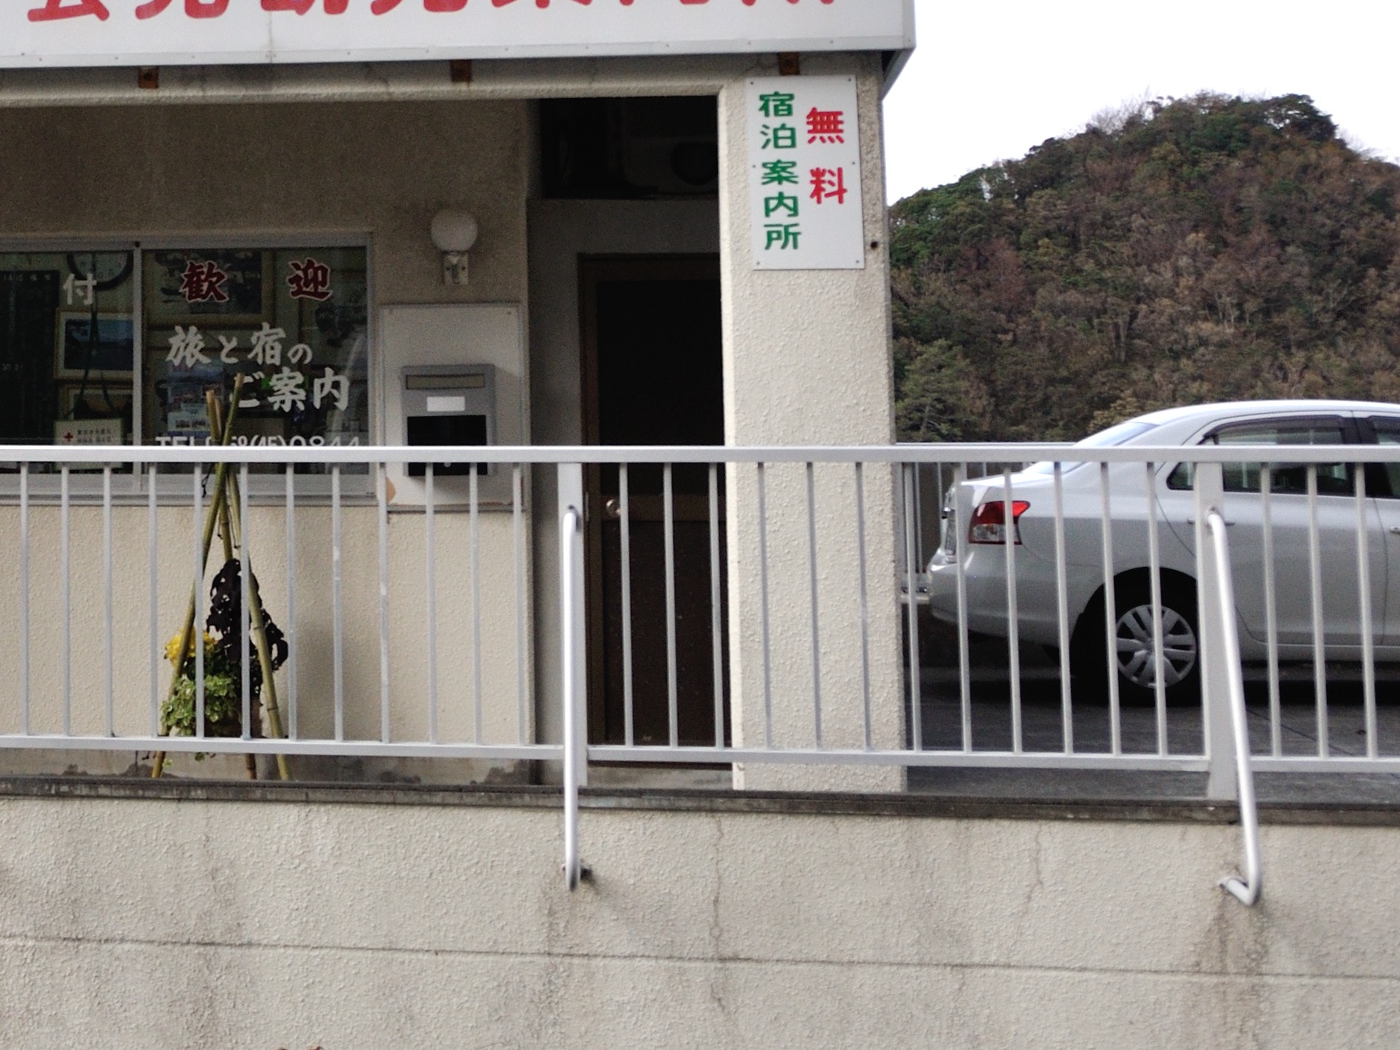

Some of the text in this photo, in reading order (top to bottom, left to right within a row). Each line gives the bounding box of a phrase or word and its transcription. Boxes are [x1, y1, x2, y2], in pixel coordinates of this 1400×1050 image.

[758, 91, 802, 251] 宿泊案内所
[806, 107, 848, 205] 無料
[180, 257, 333, 303] 歓迎
[165, 322, 313, 367] 旅と宿の
[230, 366, 350, 412] ご案内
